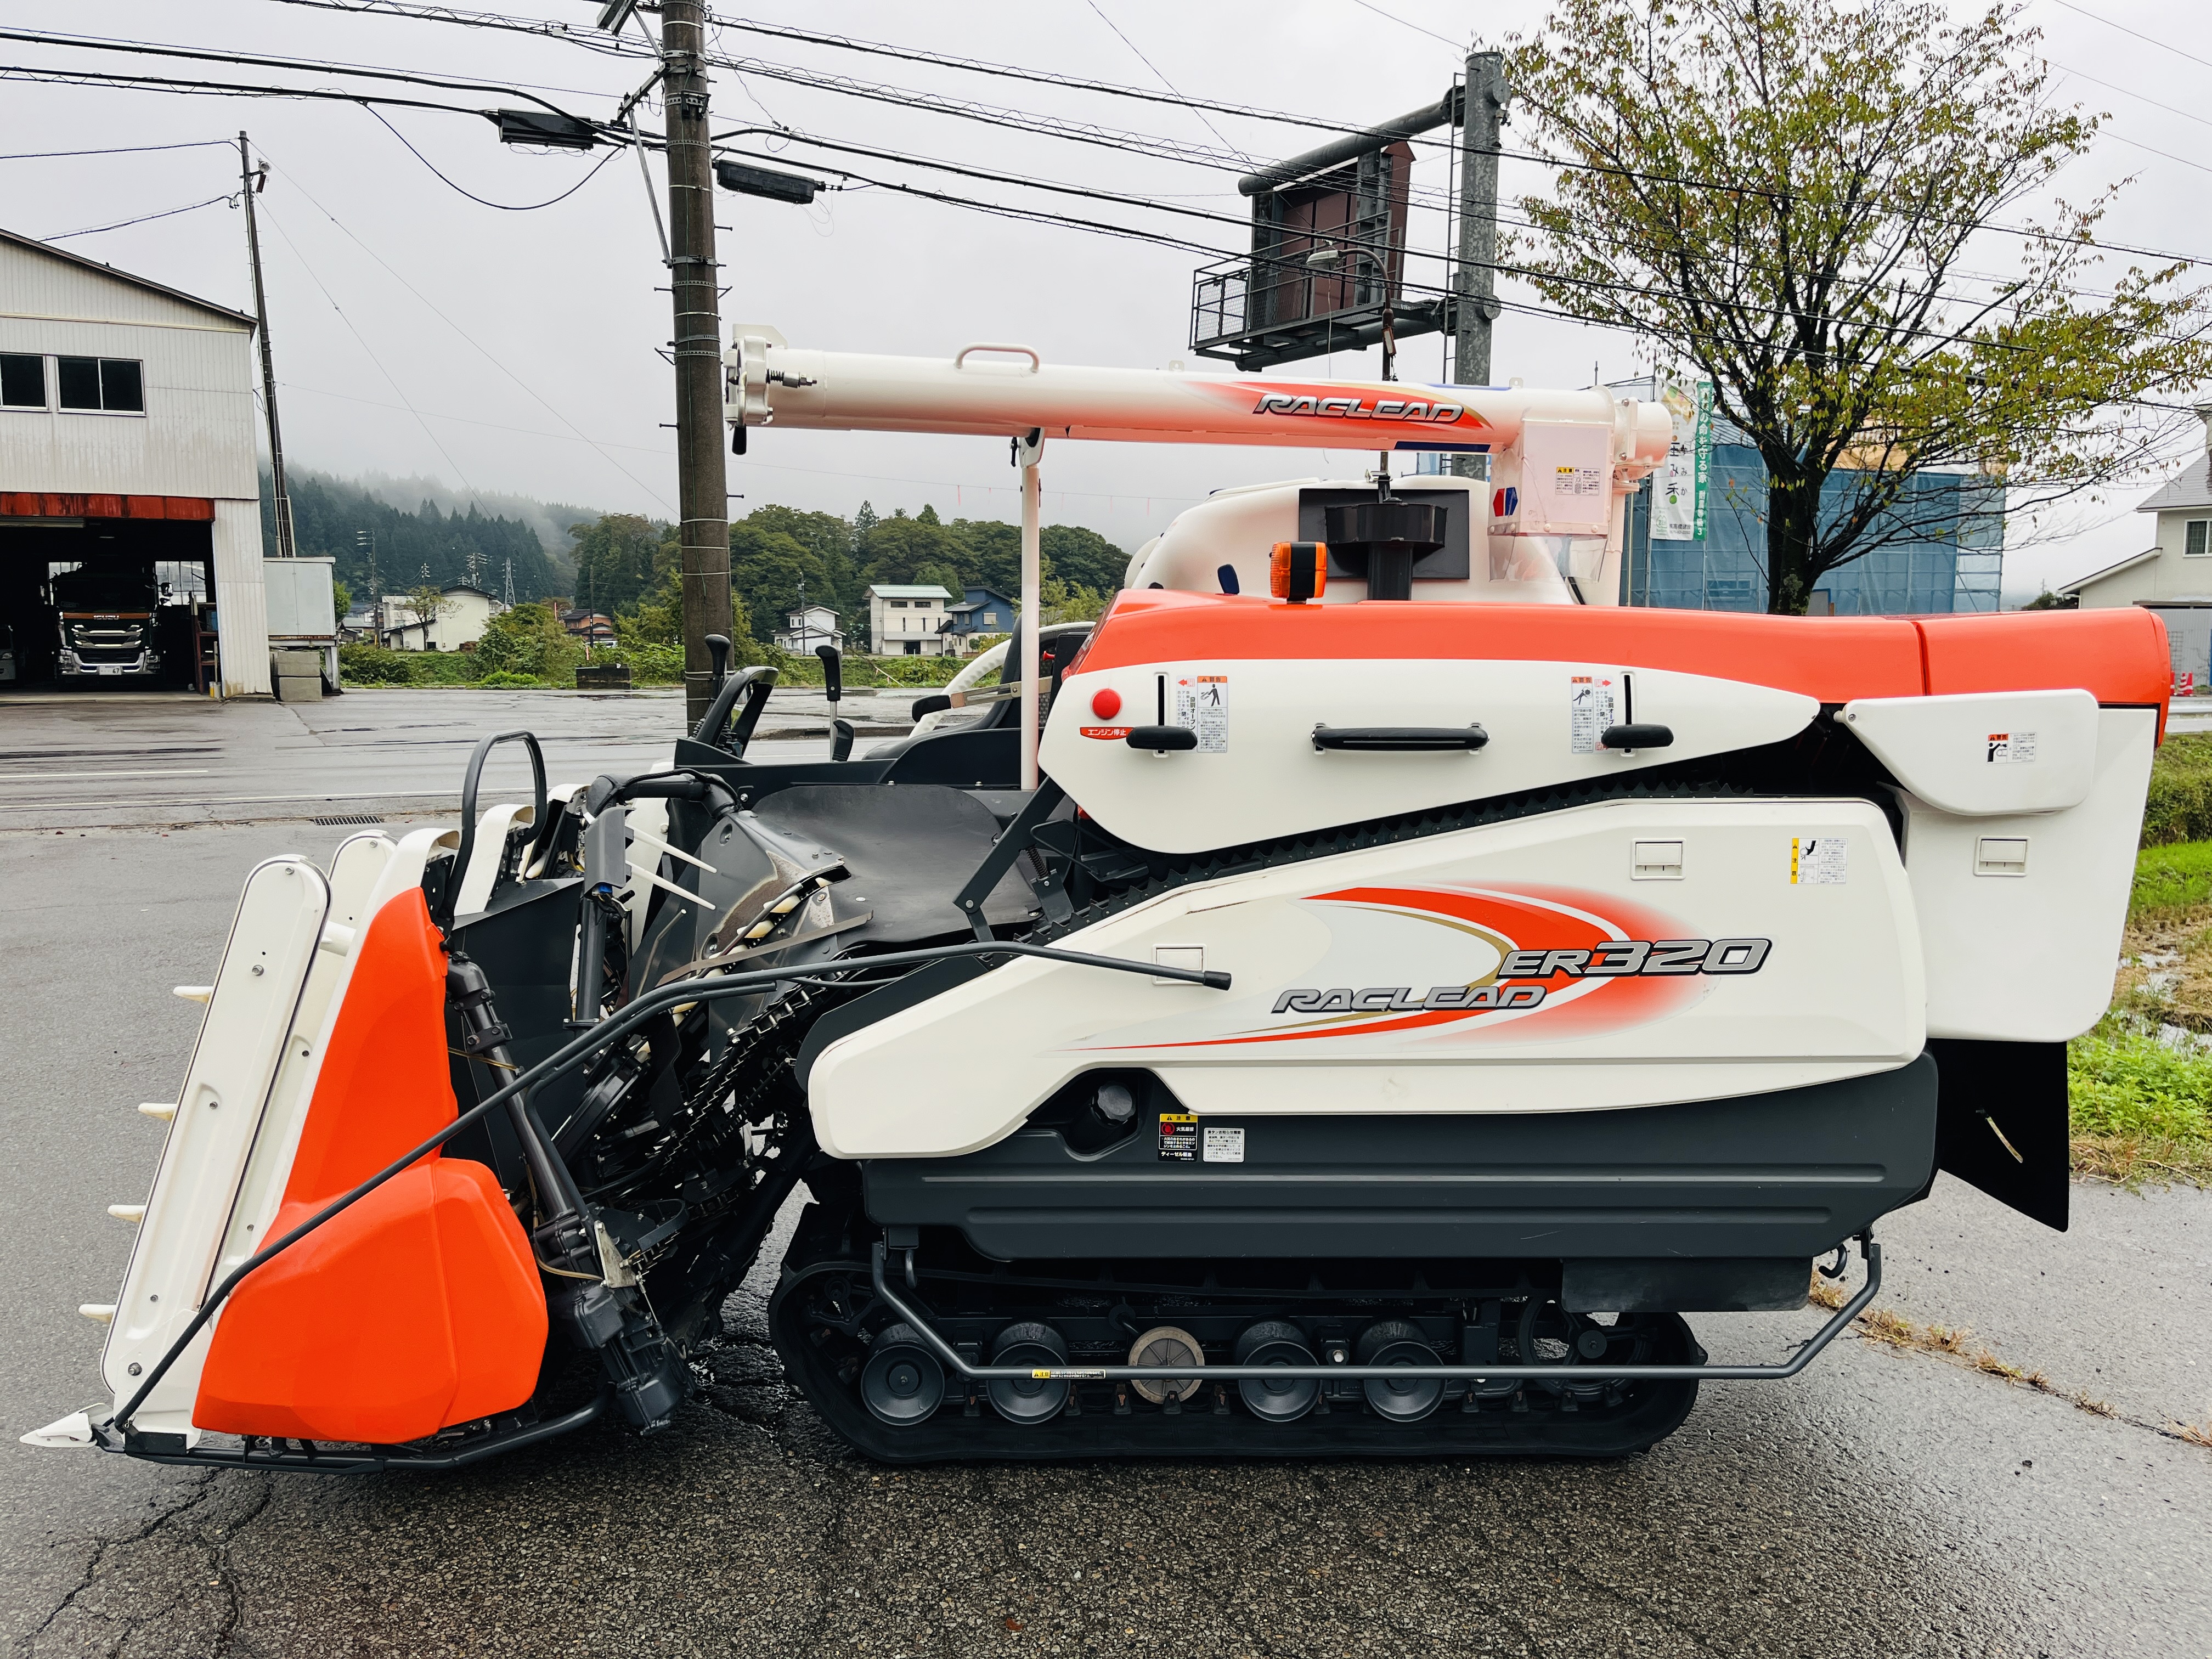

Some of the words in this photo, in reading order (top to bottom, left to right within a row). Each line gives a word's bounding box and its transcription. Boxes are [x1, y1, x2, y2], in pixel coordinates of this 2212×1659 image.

[1253, 393, 1464, 423] RACLEAD
[1495, 938, 1771, 979] ER320
[1271, 986, 1548, 1014] RACLEAD
